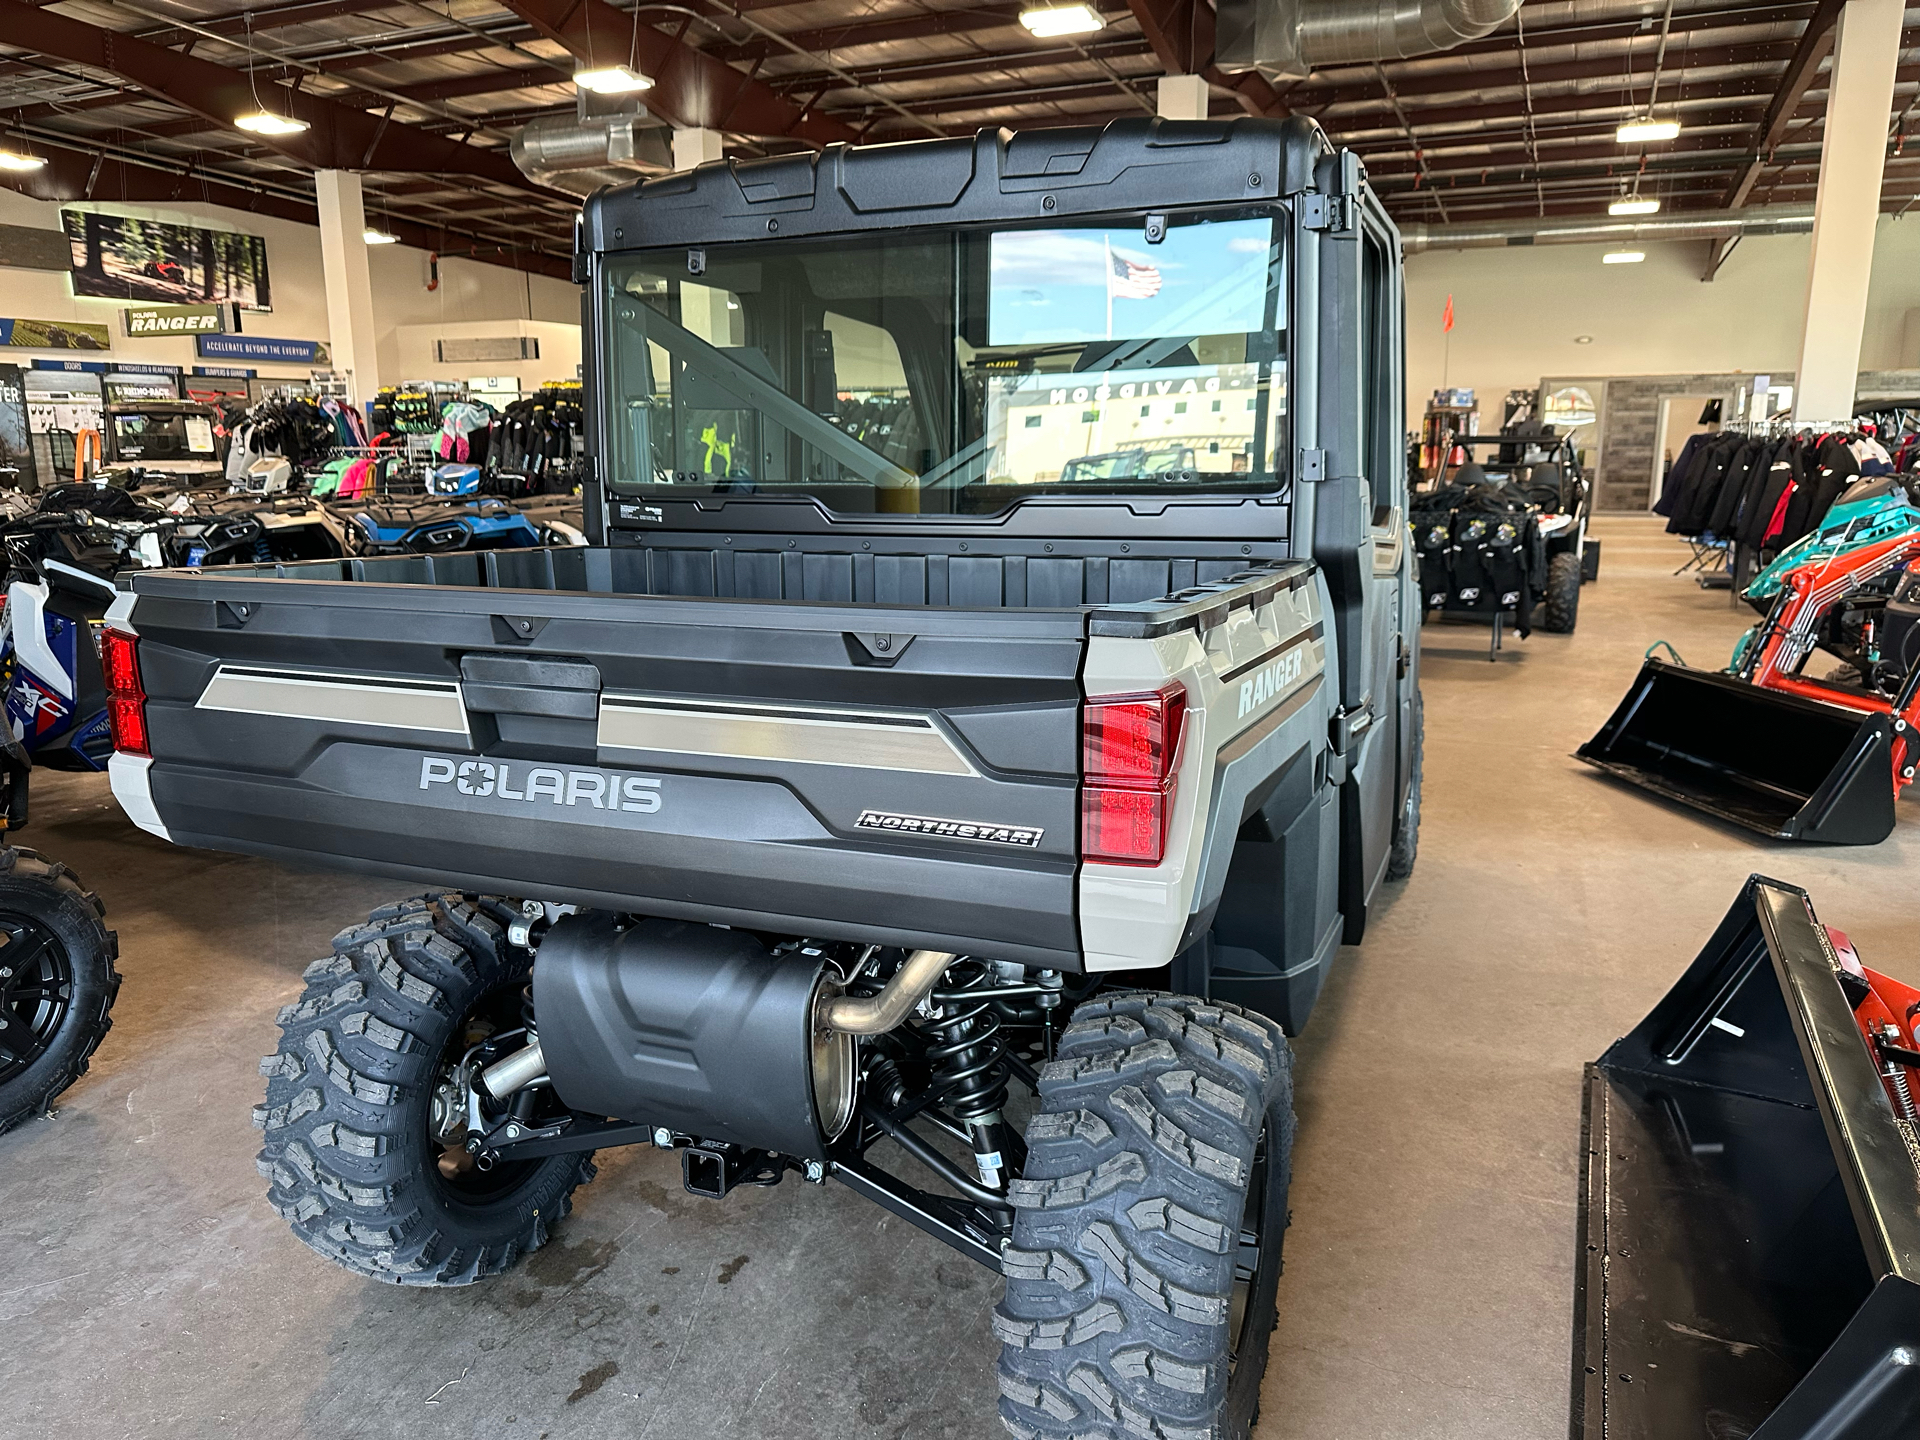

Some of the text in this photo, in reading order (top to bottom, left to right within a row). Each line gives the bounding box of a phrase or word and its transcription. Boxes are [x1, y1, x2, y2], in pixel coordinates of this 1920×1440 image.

[130, 315, 218, 332] RANGER
[206, 341, 310, 356] ACCELERATE BEYOND THE EVERYDAY
[64, 361, 82, 371] DOORS
[205, 368, 226, 377] BUMPERS
[230, 369, 248, 378] GUARDS
[1237, 648, 1303, 720] RANGER
[419, 755, 662, 814] POLARIS
[862, 812, 1036, 844] NORTHSTAR
